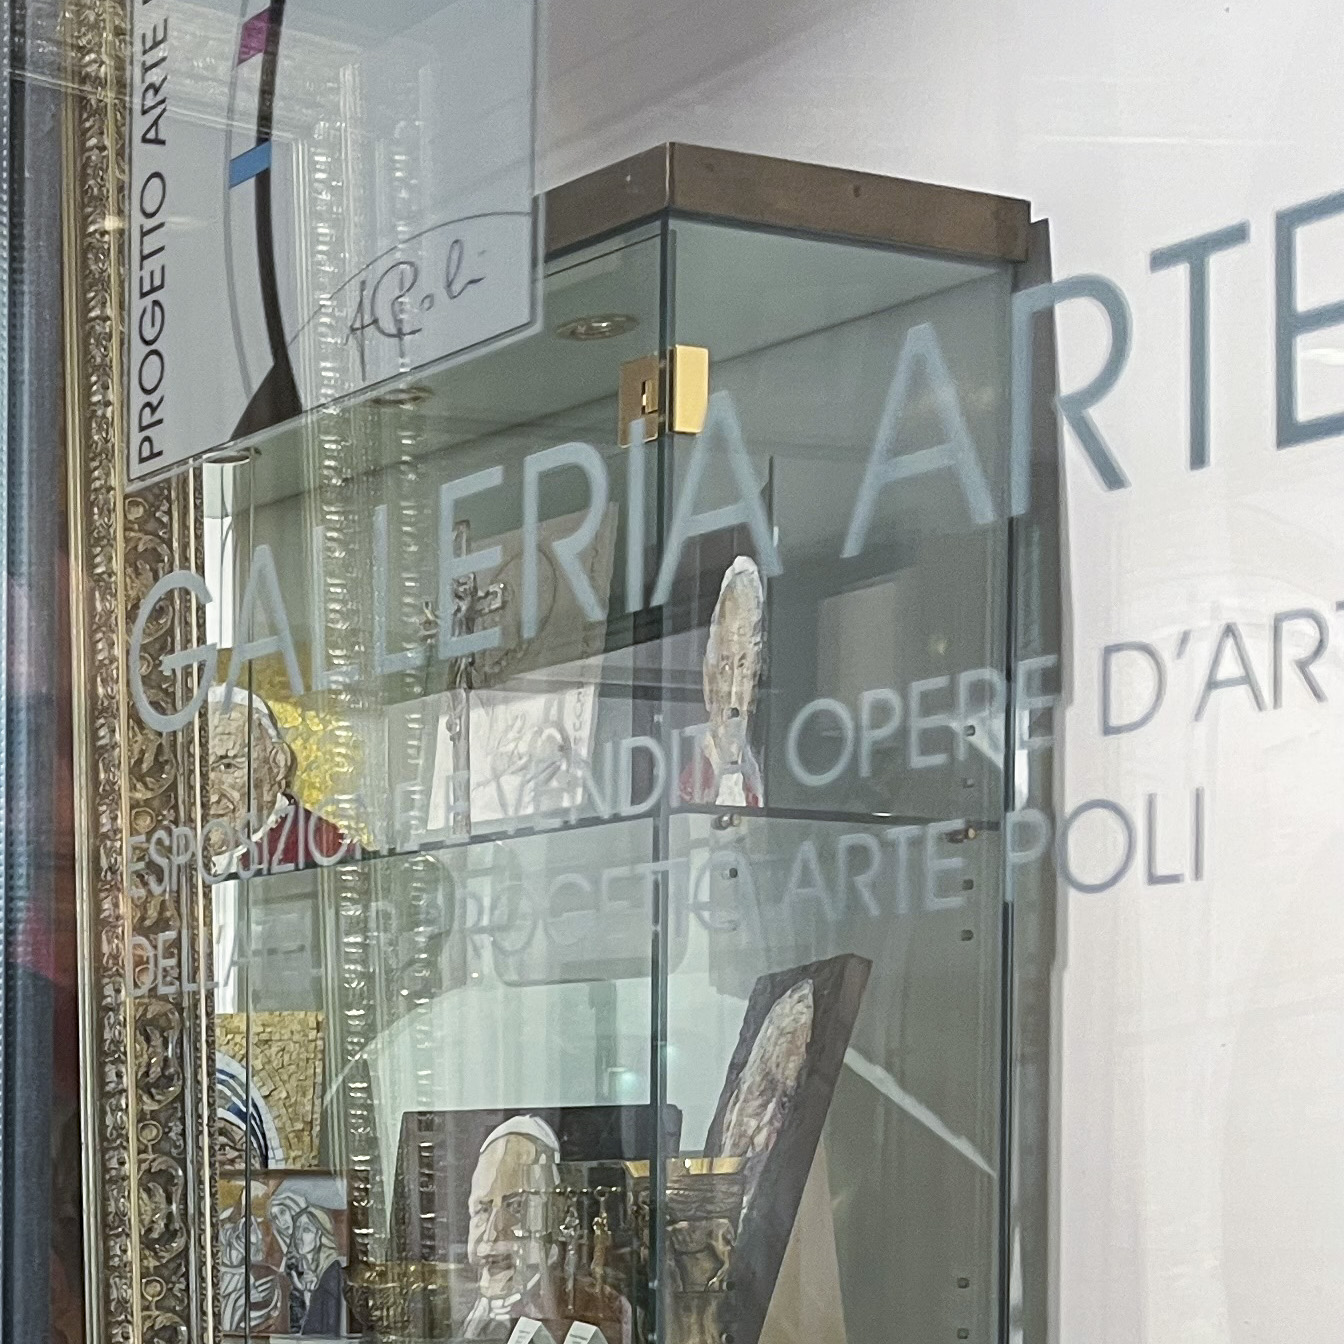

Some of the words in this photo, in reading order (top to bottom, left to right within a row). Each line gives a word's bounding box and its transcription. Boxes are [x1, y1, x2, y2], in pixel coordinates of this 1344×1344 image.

[141, 16, 169, 146] ARTE
[137, 171, 166, 466] PROGETTO
[127, 390, 782, 734] GALLERIA
[841, 190, 1344, 560] ARTE
[786, 654, 1060, 788] OPERE
[1103, 600, 1344, 737] D'AR
[422, 850, 750, 976] ROGETTO
[782, 819, 967, 923] ARTE
[1005, 786, 1205, 903] POLI
